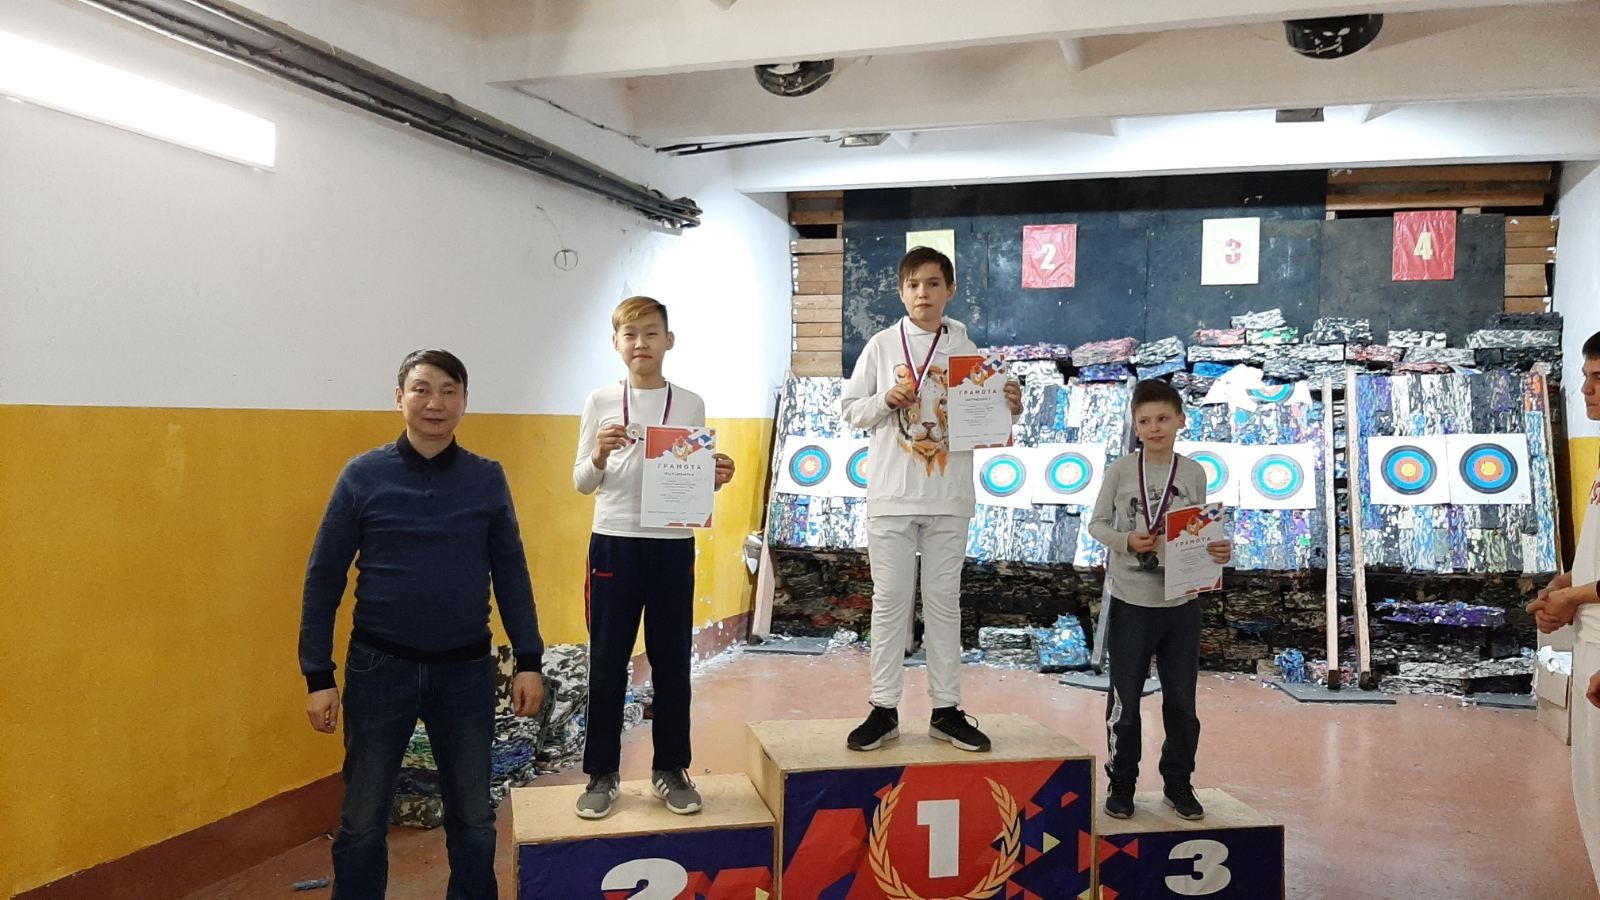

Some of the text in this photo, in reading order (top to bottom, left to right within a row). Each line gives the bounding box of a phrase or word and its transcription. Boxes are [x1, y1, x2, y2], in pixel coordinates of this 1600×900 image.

[1041, 243, 1056, 271] 2
[1224, 238, 1242, 265] 3
[1414, 231, 1434, 261] 4
[958, 388, 998, 396] ГРАМОТА
[657, 463, 703, 471] ГРАМОТА
[1175, 536, 1212, 548] ГРАМОТА
[917, 799, 960, 878] 1
[1165, 839, 1231, 896] 3
